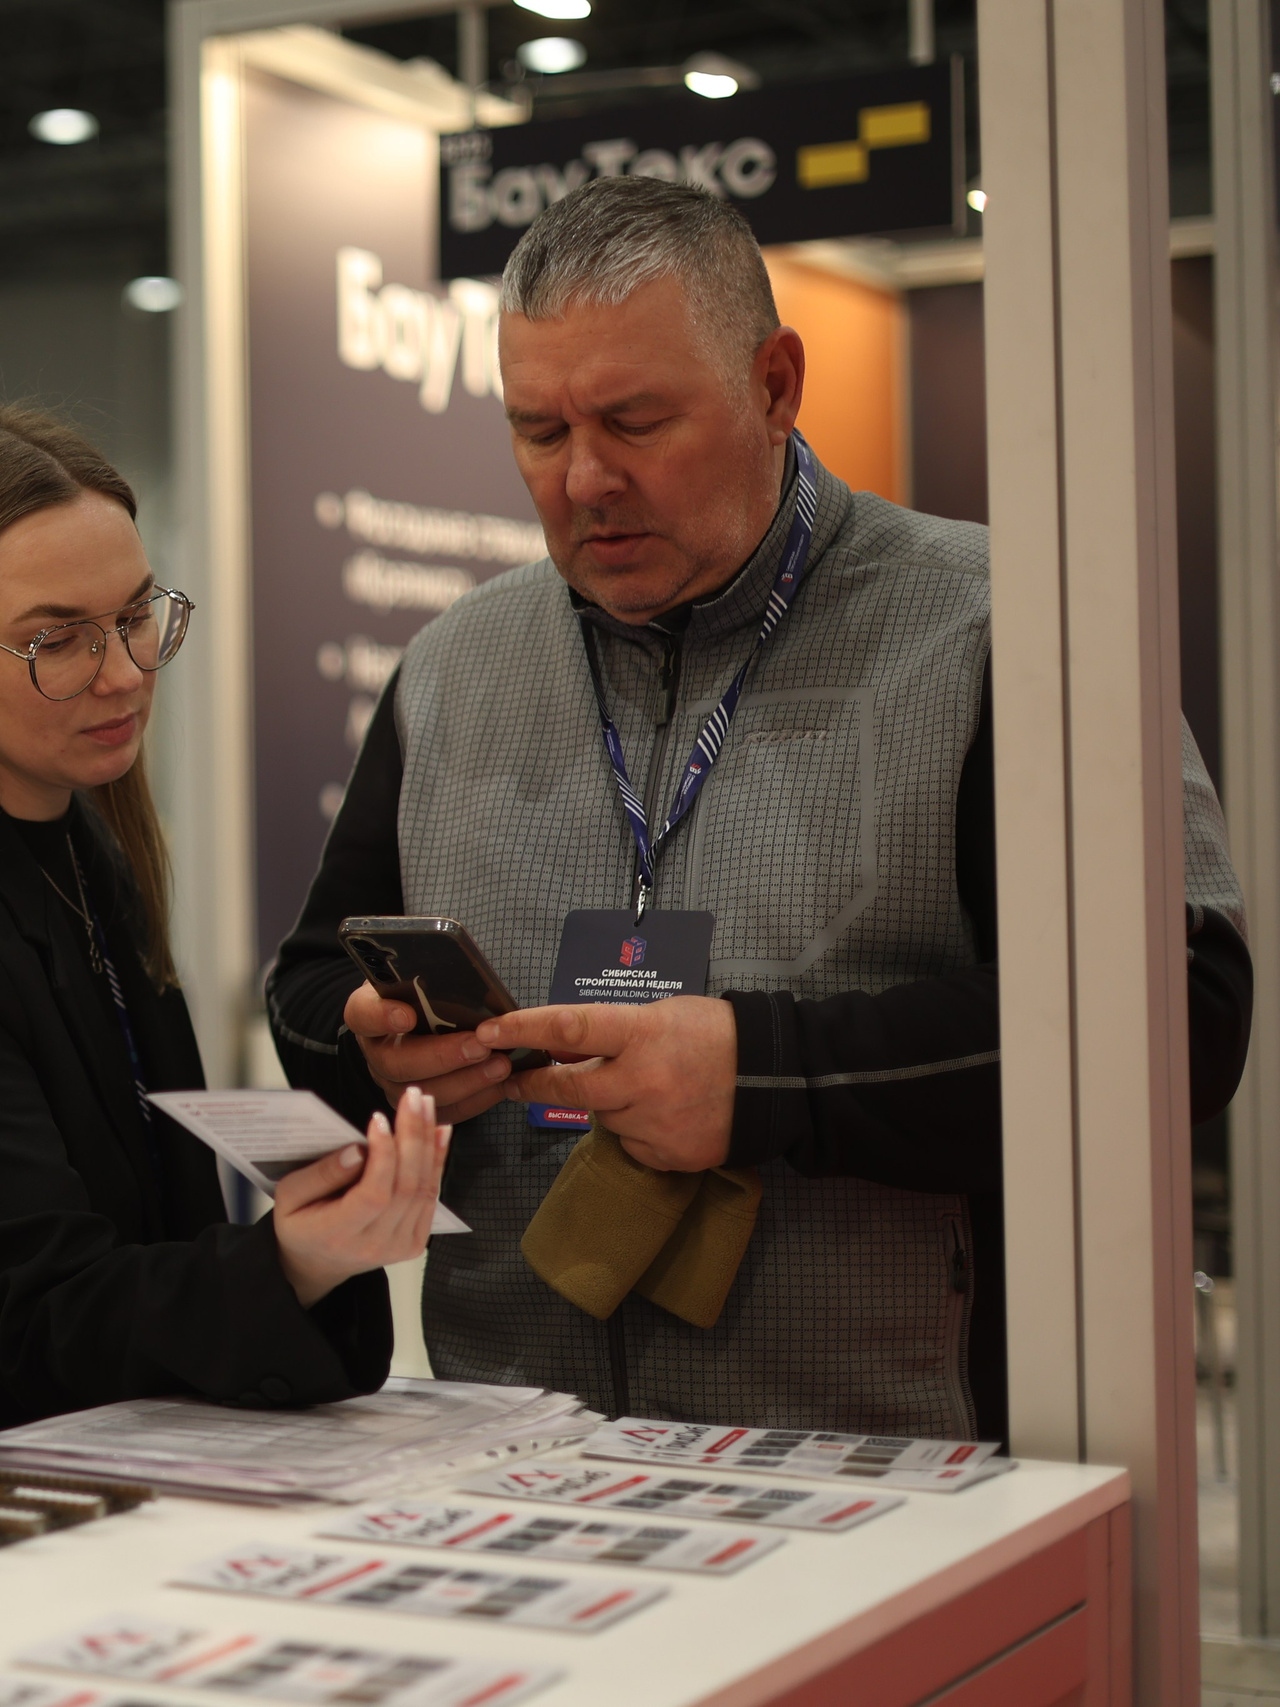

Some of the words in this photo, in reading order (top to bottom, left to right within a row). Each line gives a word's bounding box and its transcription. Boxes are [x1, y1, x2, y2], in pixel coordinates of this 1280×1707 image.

[336, 246, 506, 414] БауТ
[601, 969, 658, 979] СИБИРСКАЯ
[574, 978, 645, 988] СТРОИТЕЛЬНАЯ
[646, 980, 683, 990] НЕДЕЛЯ
[578, 988, 613, 997] SIBERIAN
[613, 989, 650, 999] BUILDING
